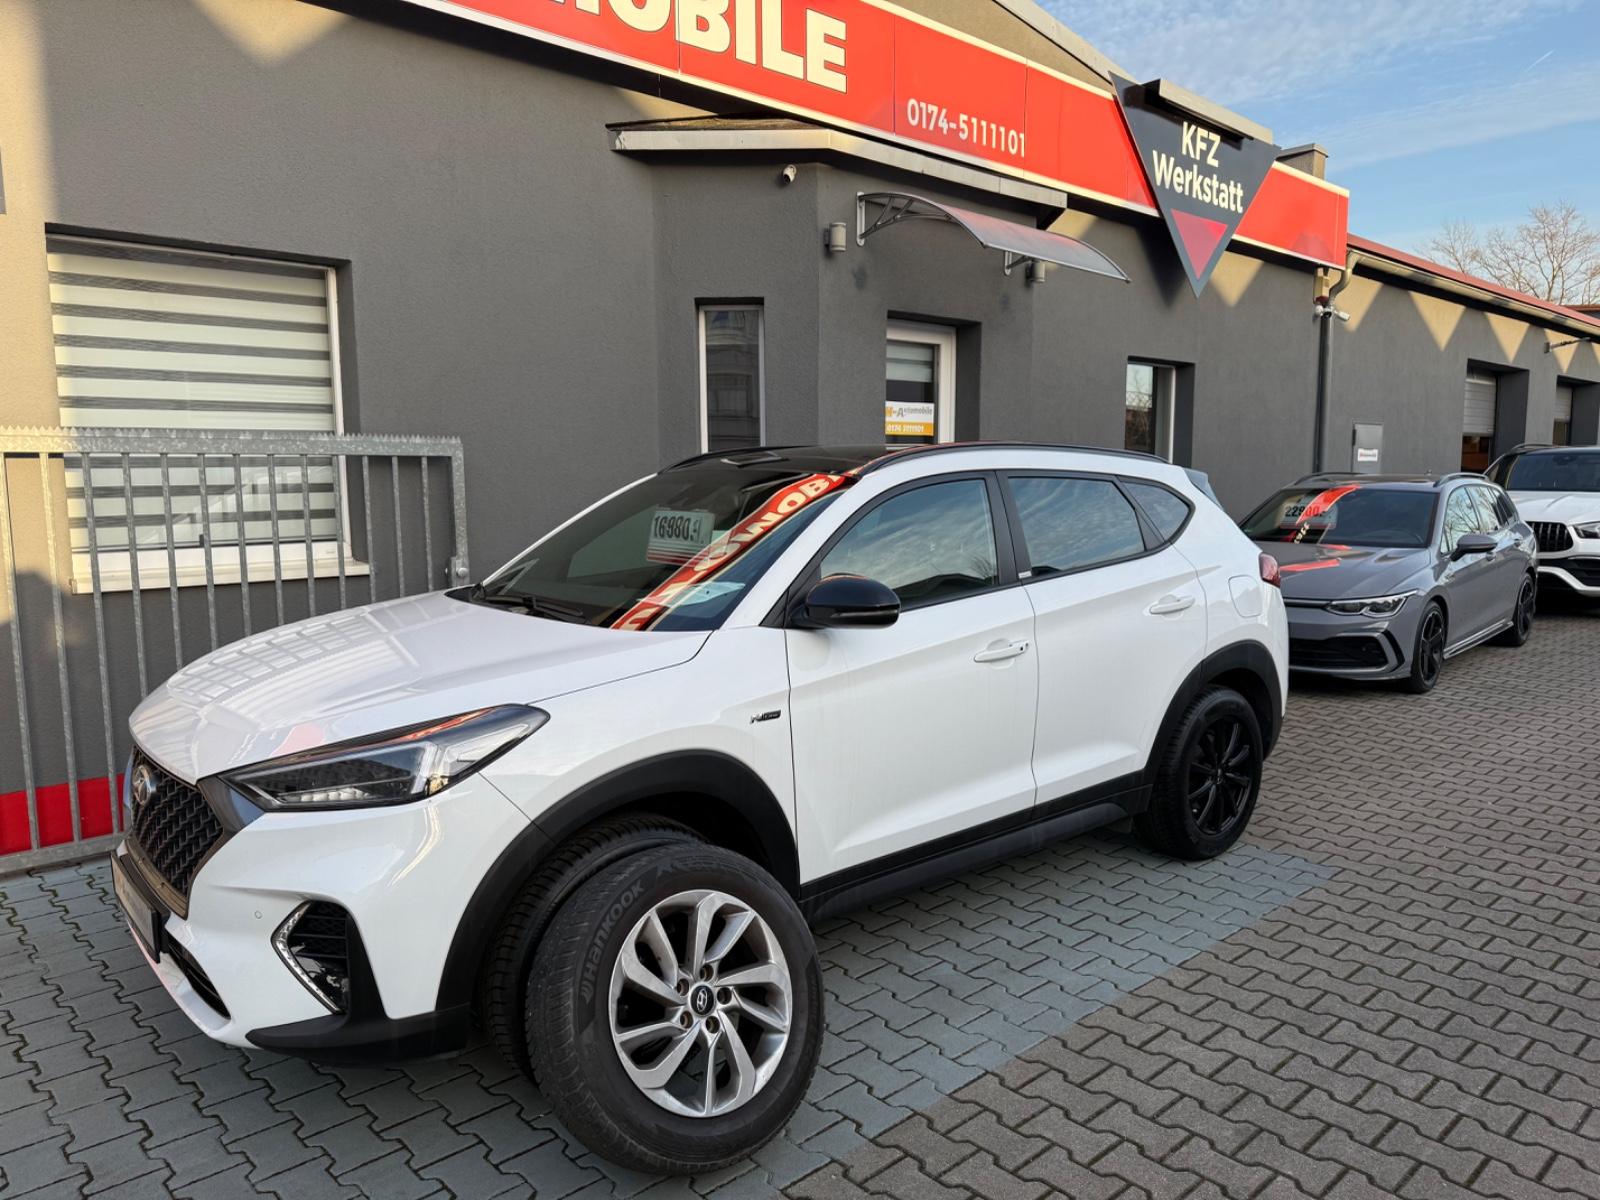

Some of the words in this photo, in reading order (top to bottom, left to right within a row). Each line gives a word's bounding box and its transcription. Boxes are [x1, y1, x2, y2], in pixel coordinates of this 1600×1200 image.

[907, 98, 1025, 158] 0174-5111101
[1181, 121, 1221, 168] KFZ
[1152, 150, 1244, 214] Werkstatt
